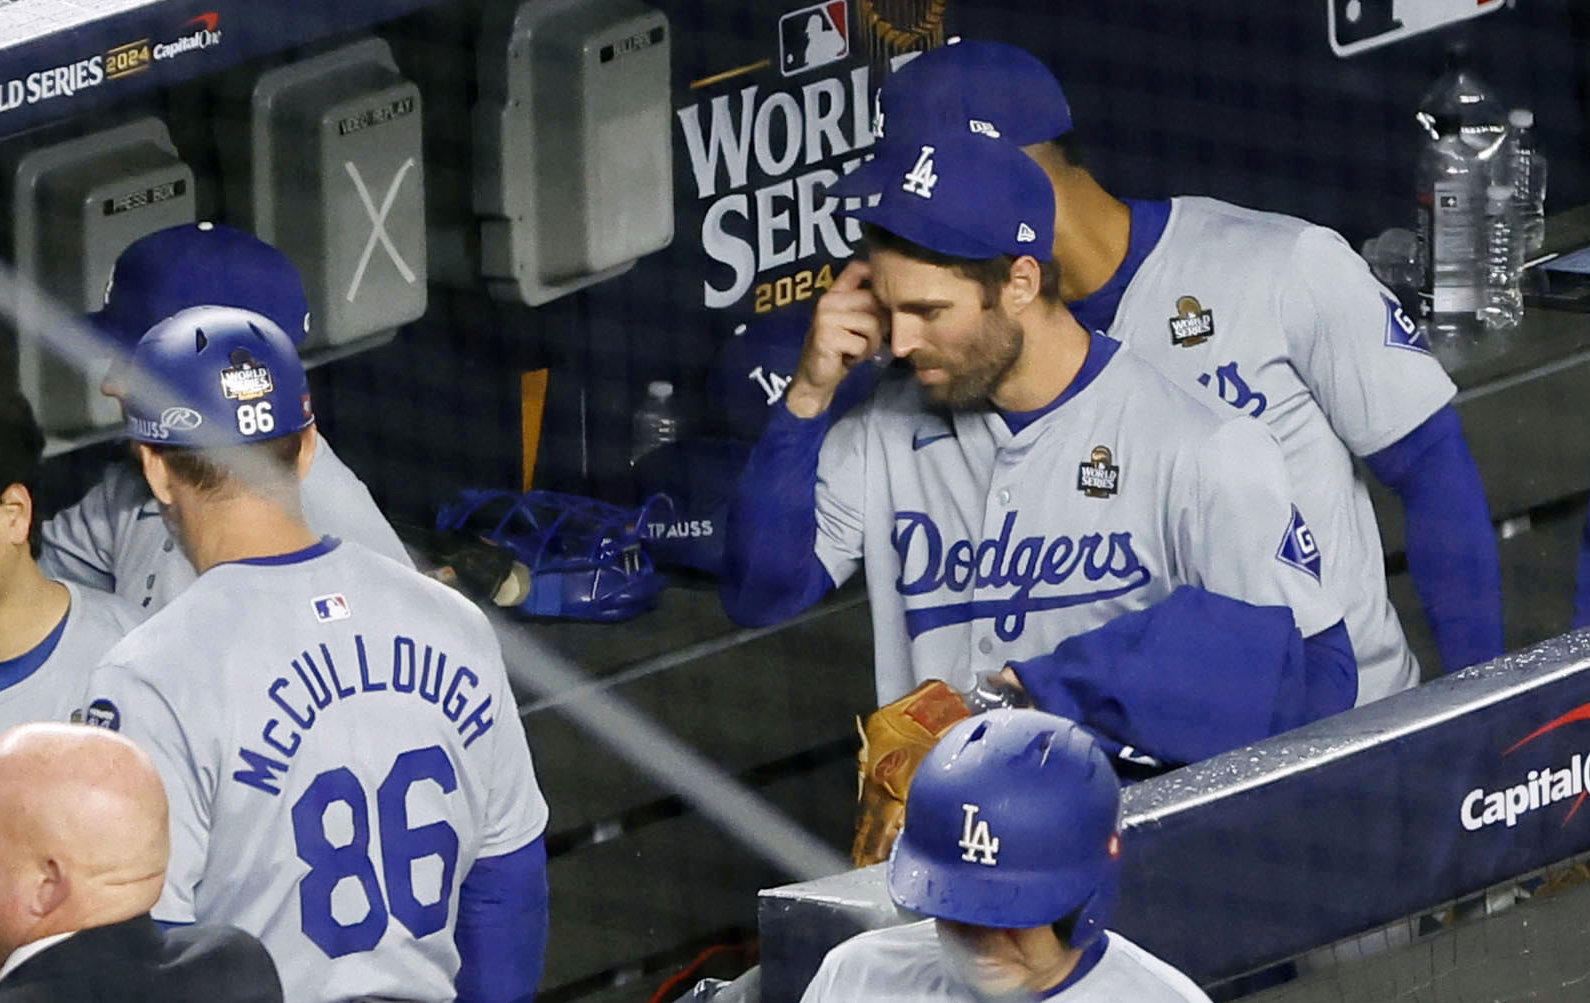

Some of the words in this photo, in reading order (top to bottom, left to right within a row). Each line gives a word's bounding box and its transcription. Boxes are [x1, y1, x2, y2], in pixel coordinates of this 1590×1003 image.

[26, 55, 104, 104] SERIES
[106, 46, 150, 73] 2024
[677, 52, 922, 199] WORL
[902, 145, 938, 199] LA
[755, 263, 836, 313] 2024
[1171, 313, 1212, 332] WORLD
[1174, 322, 1213, 340] SERIES
[225, 367, 267, 382] WORLD
[236, 401, 275, 436] 86
[1081, 465, 1116, 480] WORLD
[1081, 475, 1115, 489] SERIES
[891, 510, 1151, 642] Dodgers
[291, 745, 459, 960] 86
[959, 803, 1000, 866] LA
